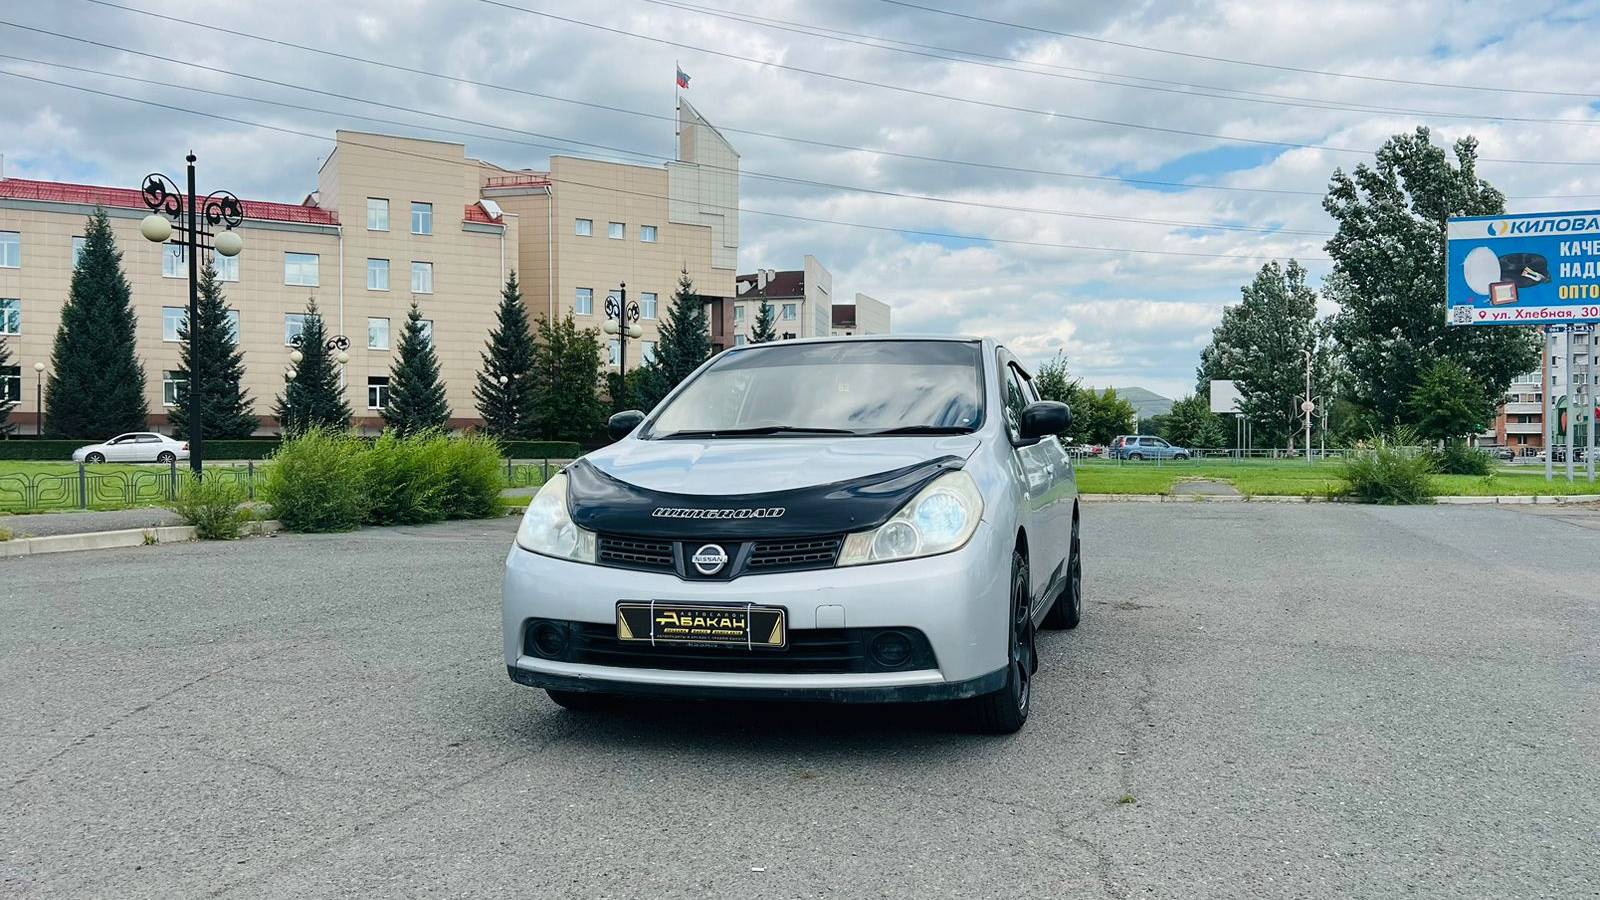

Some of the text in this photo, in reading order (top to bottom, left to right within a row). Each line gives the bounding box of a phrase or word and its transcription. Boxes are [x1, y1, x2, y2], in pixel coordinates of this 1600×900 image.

[1510, 217, 1600, 234] КИЛОВА
[1560, 262, 1600, 279] НАД
[1492, 306, 1598, 320] ул. Хлебная, 30
[652, 507, 786, 519] WINGROAD
[694, 554, 724, 563] NISSAN
[655, 610, 745, 628] АБАКАН
